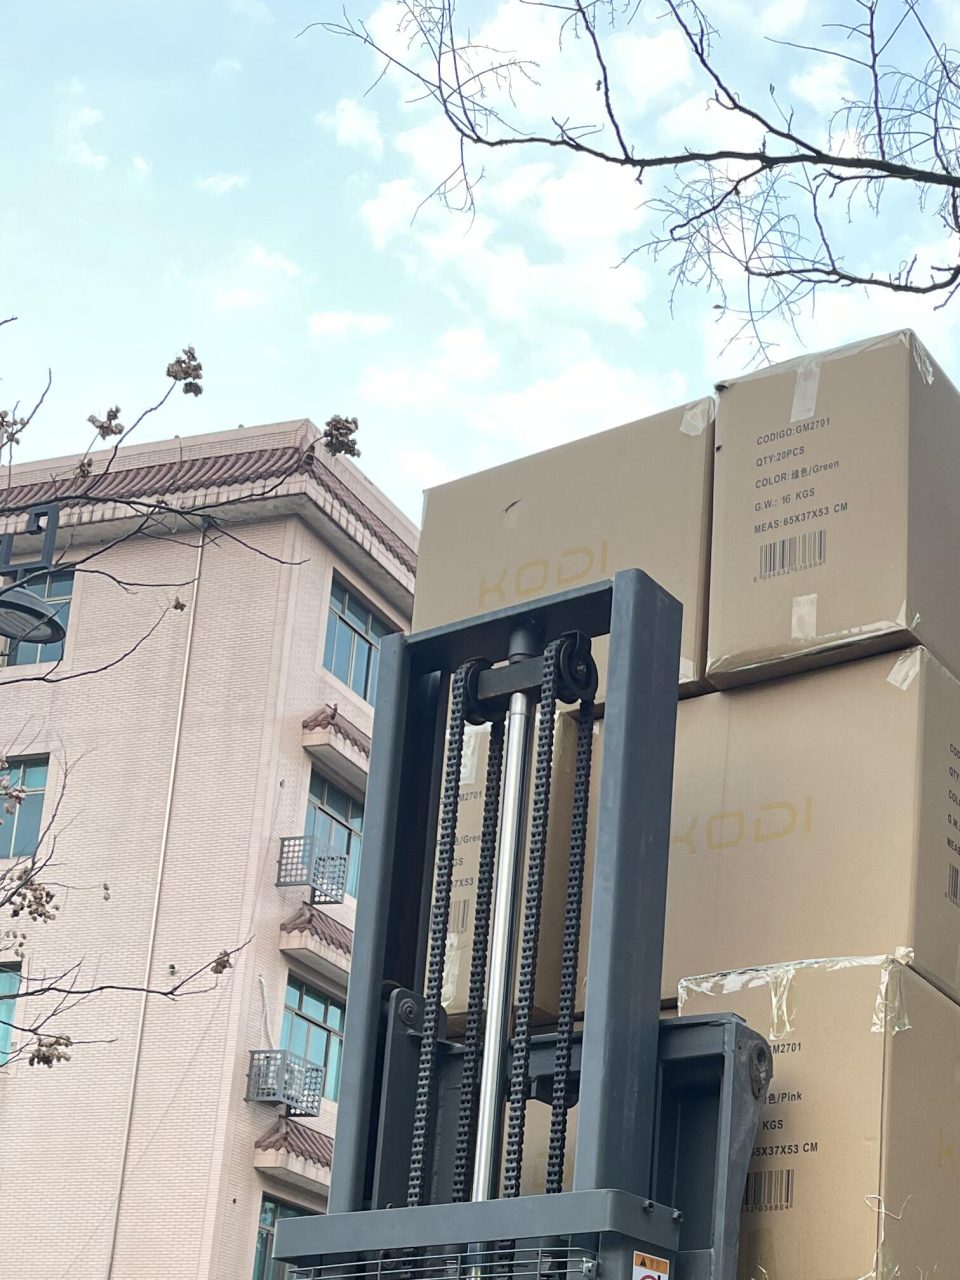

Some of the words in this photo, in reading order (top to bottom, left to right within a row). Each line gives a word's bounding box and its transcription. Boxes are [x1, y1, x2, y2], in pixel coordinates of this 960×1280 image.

[756, 417, 831, 446] CODIGO:GM2701
[755, 446, 806, 468] QTY:20PCS
[795, 488, 816, 501] KGS
[833, 502, 848, 514] CM
[479, 539, 609, 607] KODI
[764, 1091, 802, 1105] 色/Pink
[762, 1120, 784, 1131] KGS
[803, 1142, 818, 1153] CM
